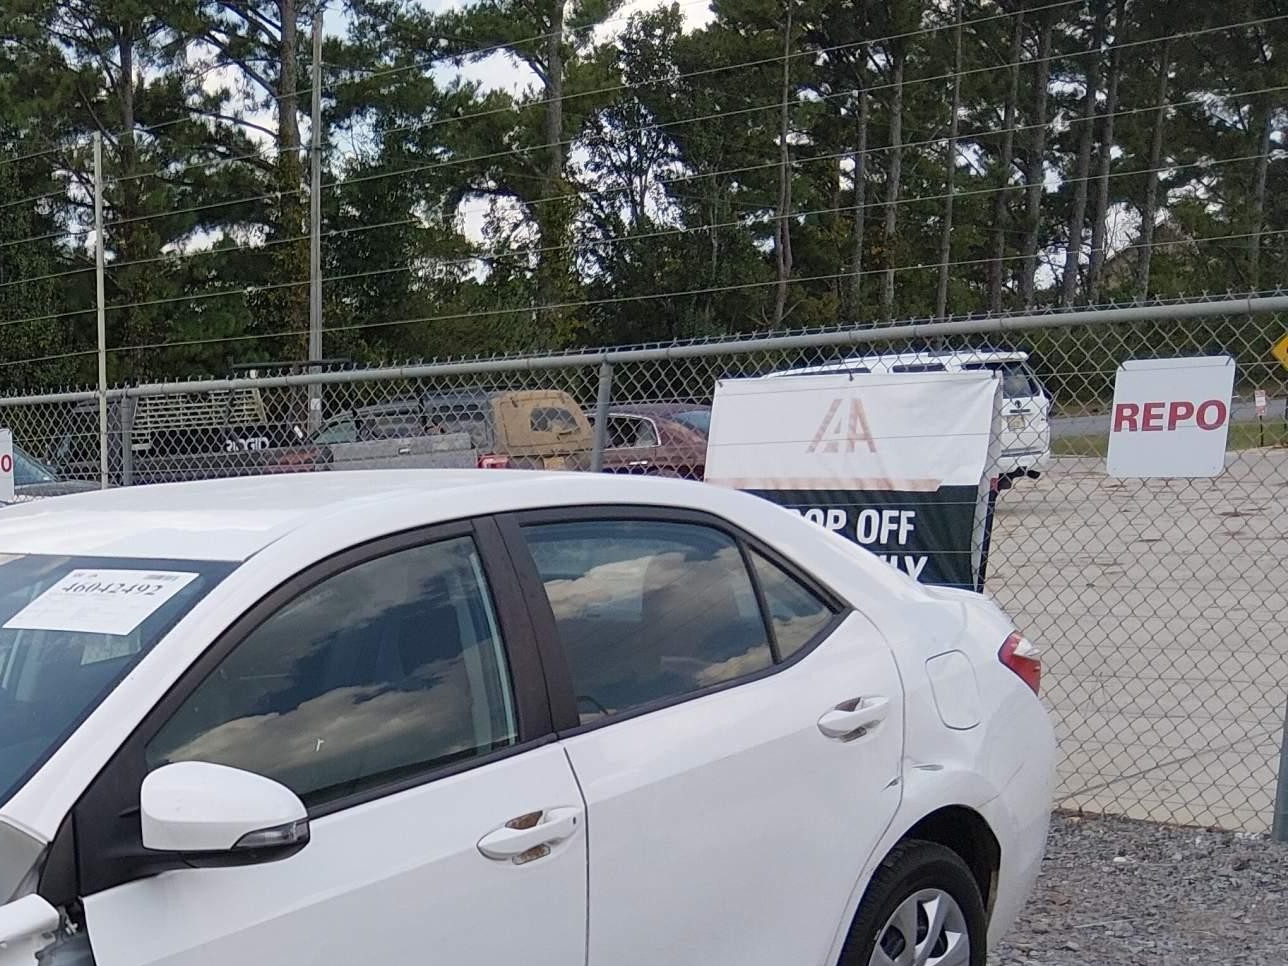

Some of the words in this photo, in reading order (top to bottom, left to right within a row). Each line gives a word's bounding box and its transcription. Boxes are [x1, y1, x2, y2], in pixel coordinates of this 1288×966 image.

[1113, 399, 1227, 432] REPO
[856, 508, 916, 545] OFF
[62, 582, 164, 596] 46042492
